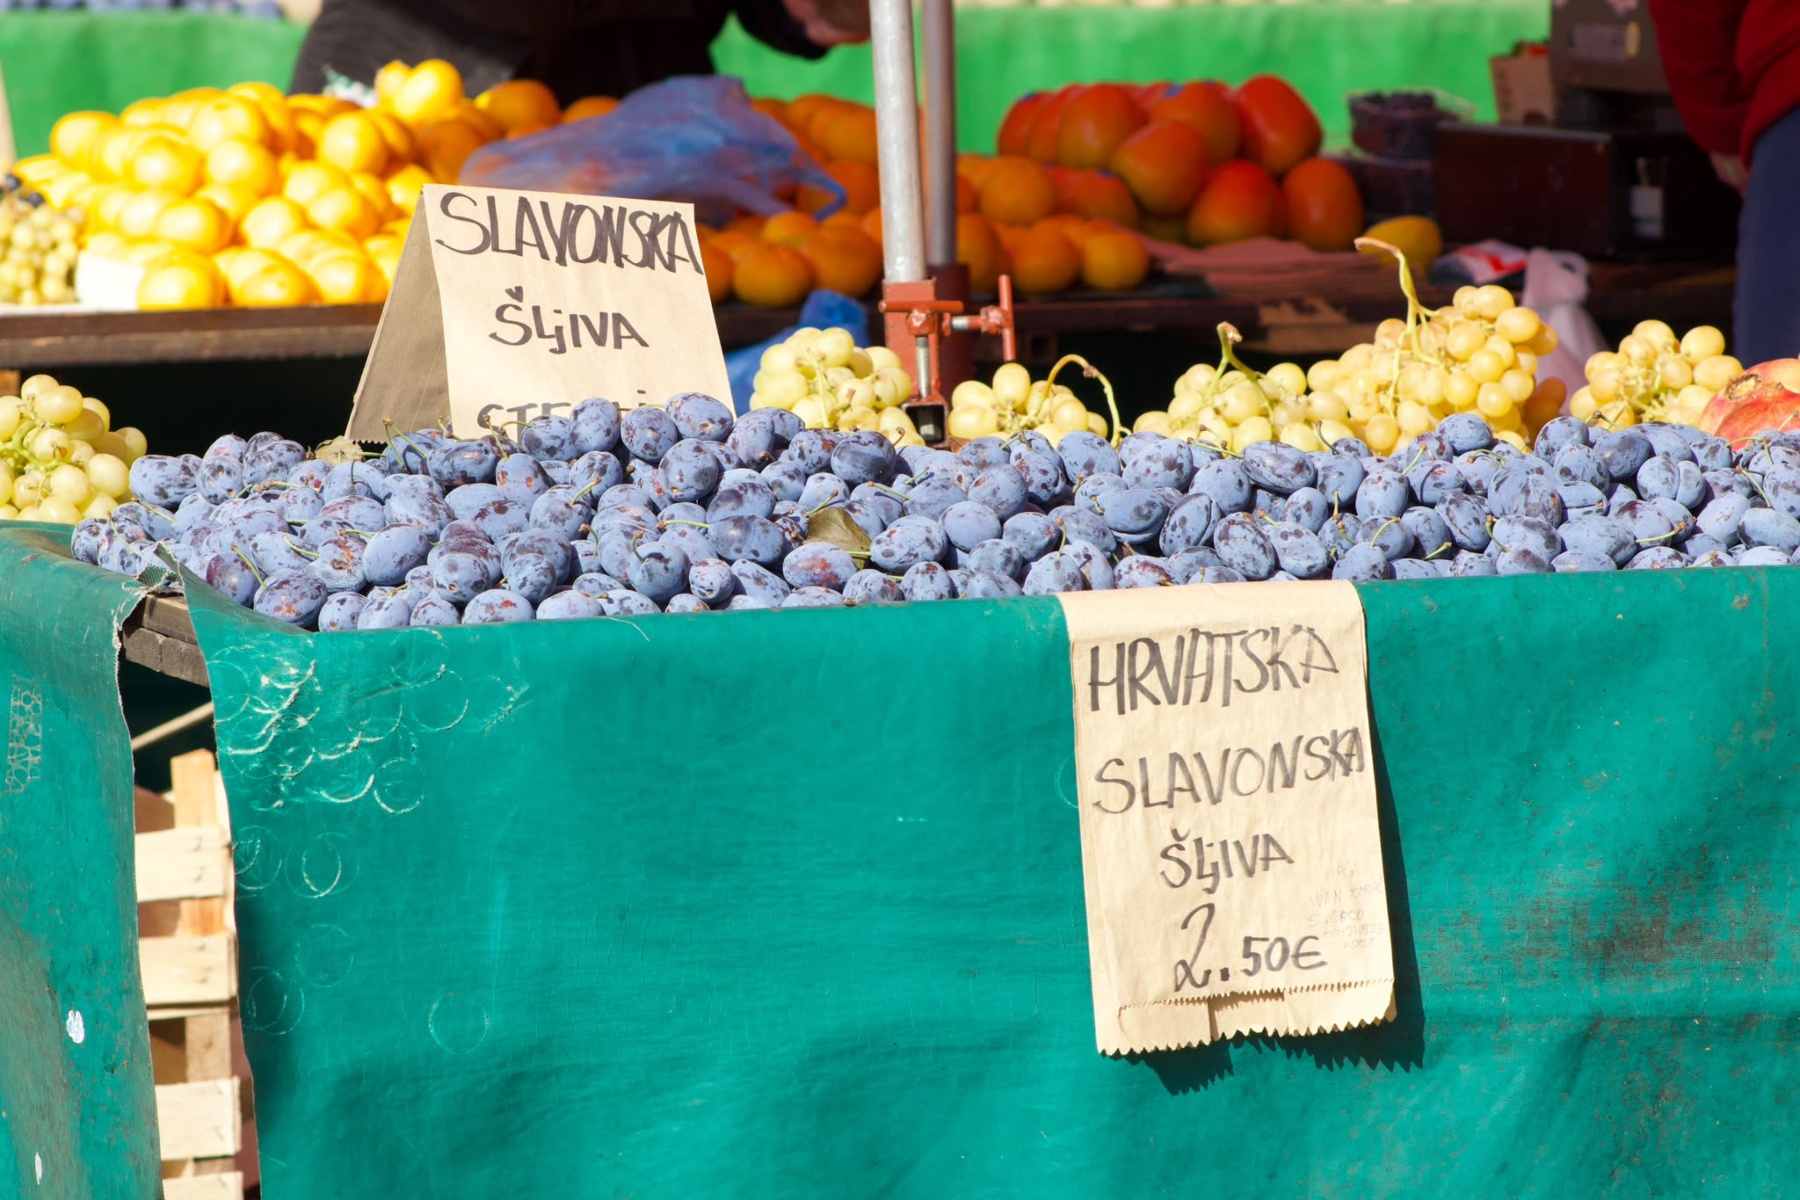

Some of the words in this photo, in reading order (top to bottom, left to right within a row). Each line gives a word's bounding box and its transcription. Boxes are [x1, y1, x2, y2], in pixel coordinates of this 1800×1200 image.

[435, 191, 704, 276] SLAVONSKA
[1088, 624, 1340, 716] HRVATSKA
[1092, 726, 1365, 814] SLAVONSKA
